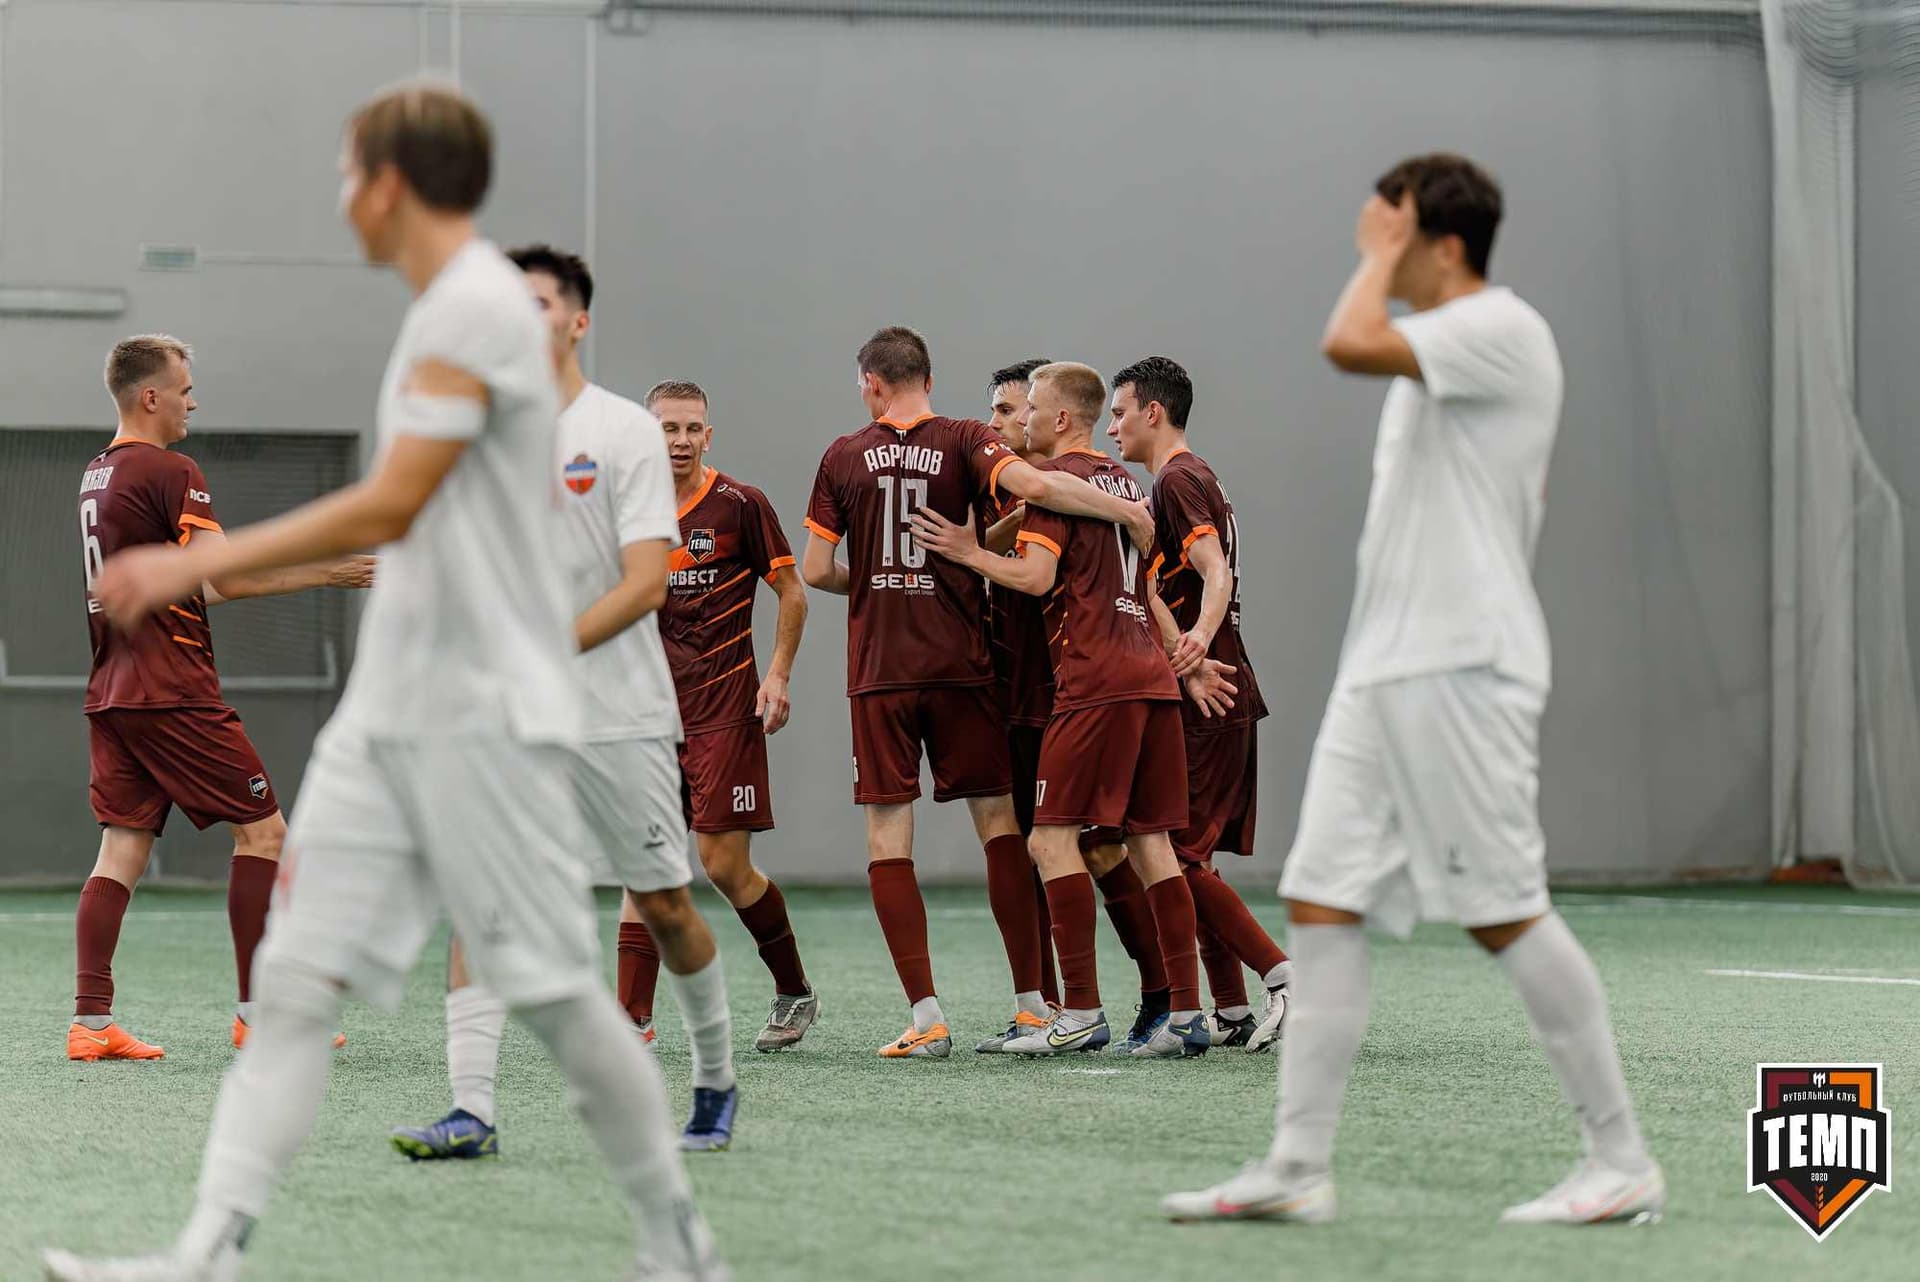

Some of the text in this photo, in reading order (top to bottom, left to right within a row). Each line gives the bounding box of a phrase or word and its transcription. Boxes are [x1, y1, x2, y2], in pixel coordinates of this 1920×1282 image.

[877, 475, 928, 568] 15
[80, 498, 103, 592] 6
[690, 538, 712, 551] ТЕМП
[871, 573, 935, 589] SEUS
[732, 785, 756, 812] 20
